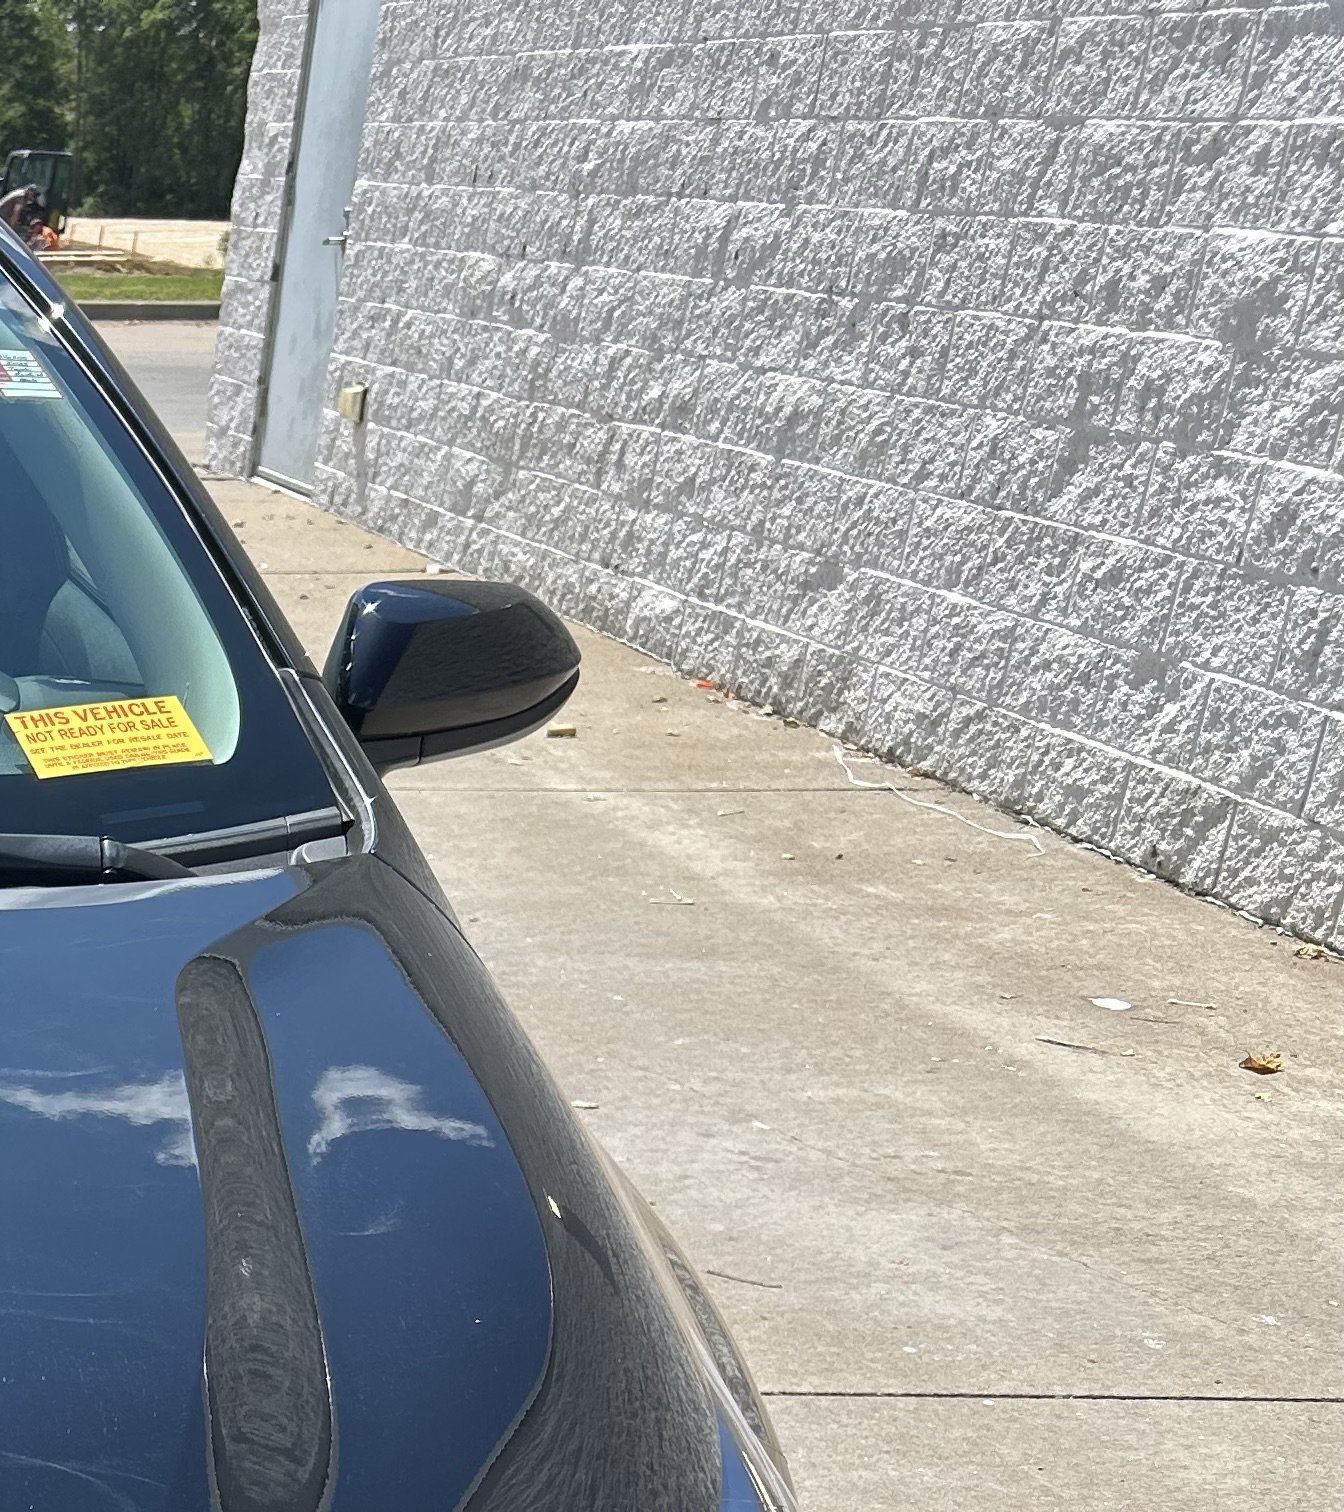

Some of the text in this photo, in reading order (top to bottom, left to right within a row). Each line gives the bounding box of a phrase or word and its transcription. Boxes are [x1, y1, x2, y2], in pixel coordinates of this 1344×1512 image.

[14, 700, 172, 730] THIS VEHICLE
[25, 716, 178, 744] NOT READY FOR SALE
[167, 731, 189, 739] DATE
